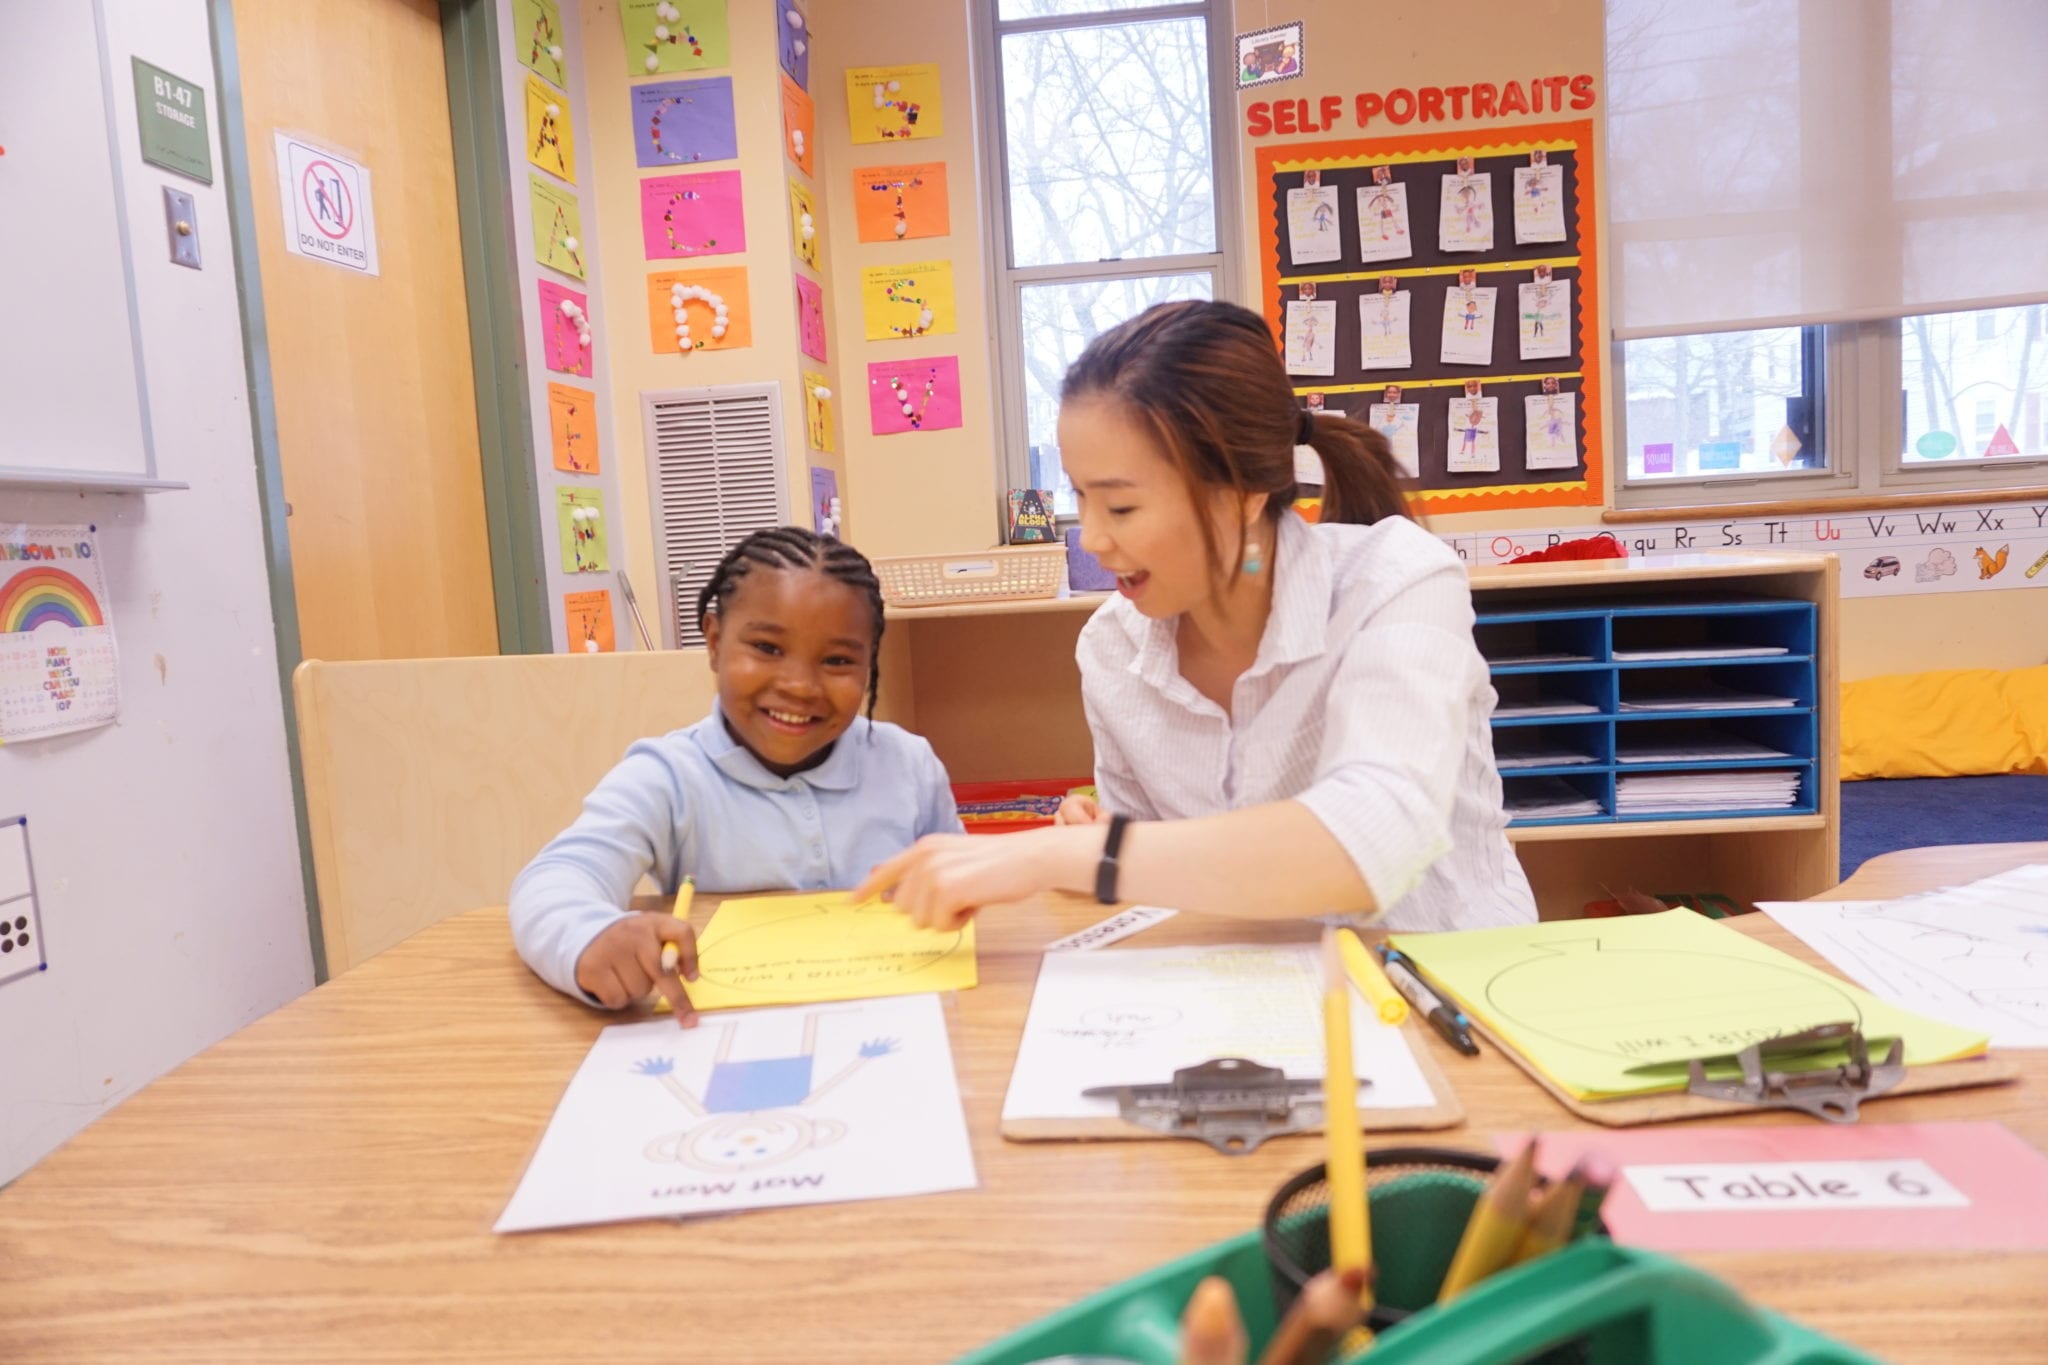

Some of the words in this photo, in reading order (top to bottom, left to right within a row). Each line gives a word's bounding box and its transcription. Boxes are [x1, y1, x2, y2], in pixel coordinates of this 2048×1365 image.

[153, 75, 192, 109] B1-47
[1247, 95, 1342, 137] SELF
[1355, 74, 1596, 129] PORTRAITS
[155, 101, 197, 129] STORAGE
[300, 233, 315, 247] DO
[316, 238, 335, 254] NOT
[337, 245, 366, 262] ENTER
[1491, 536, 1524, 557] Oo
[1675, 527, 1697, 549] Rr
[1722, 524, 1742, 546] Ss
[1764, 521, 1788, 543] Tt
[1815, 519, 1841, 541] Uu
[1867, 515, 1896, 538] Vv
[1916, 512, 1956, 535] Ww
[1976, 508, 2005, 531] Xx
[46, 657, 71, 668] MANY
[1664, 1171, 1860, 1200] Table
[1886, 1169, 1933, 1197] 6
